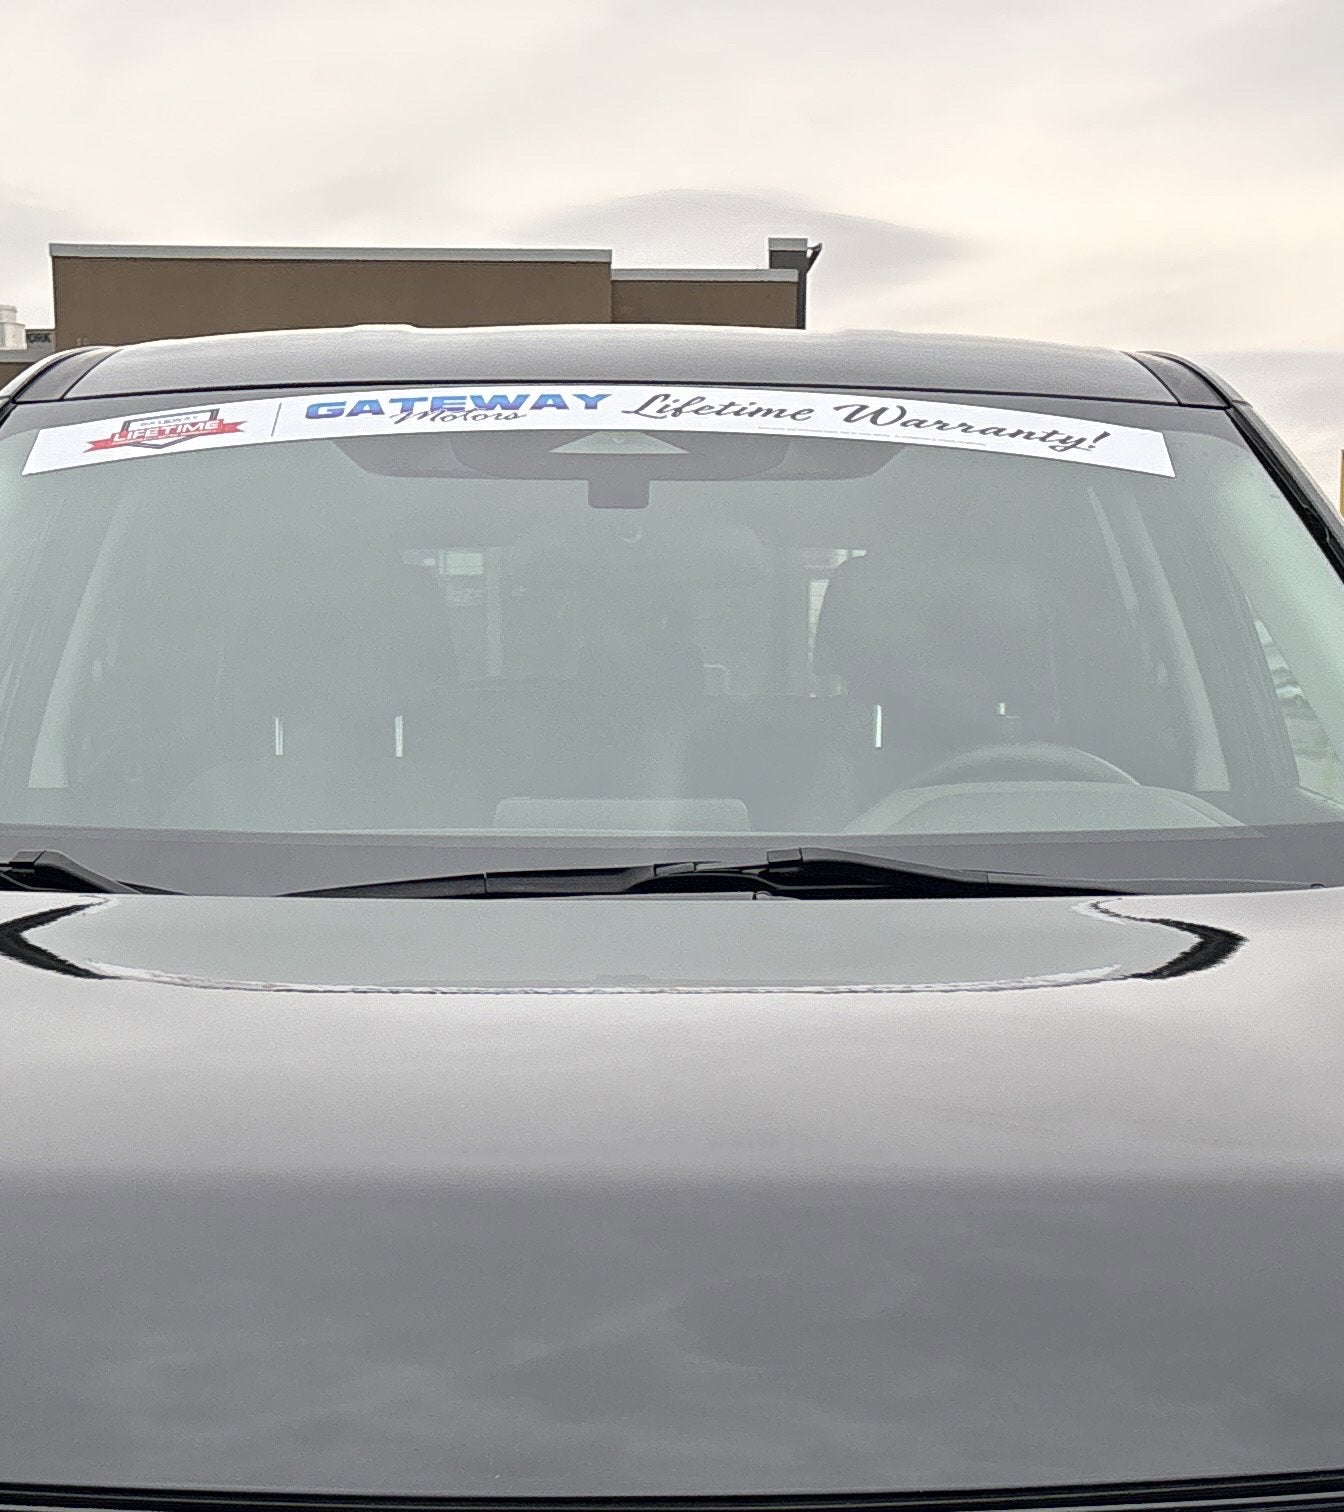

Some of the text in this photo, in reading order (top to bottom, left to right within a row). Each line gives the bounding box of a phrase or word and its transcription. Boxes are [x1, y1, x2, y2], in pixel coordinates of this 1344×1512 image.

[305, 393, 613, 420] GATEWAY
[389, 408, 528, 425] Motors
[112, 420, 221, 442] LIFETIME
[622, 393, 815, 422] Lifetime
[833, 404, 1111, 453] Warranty!
